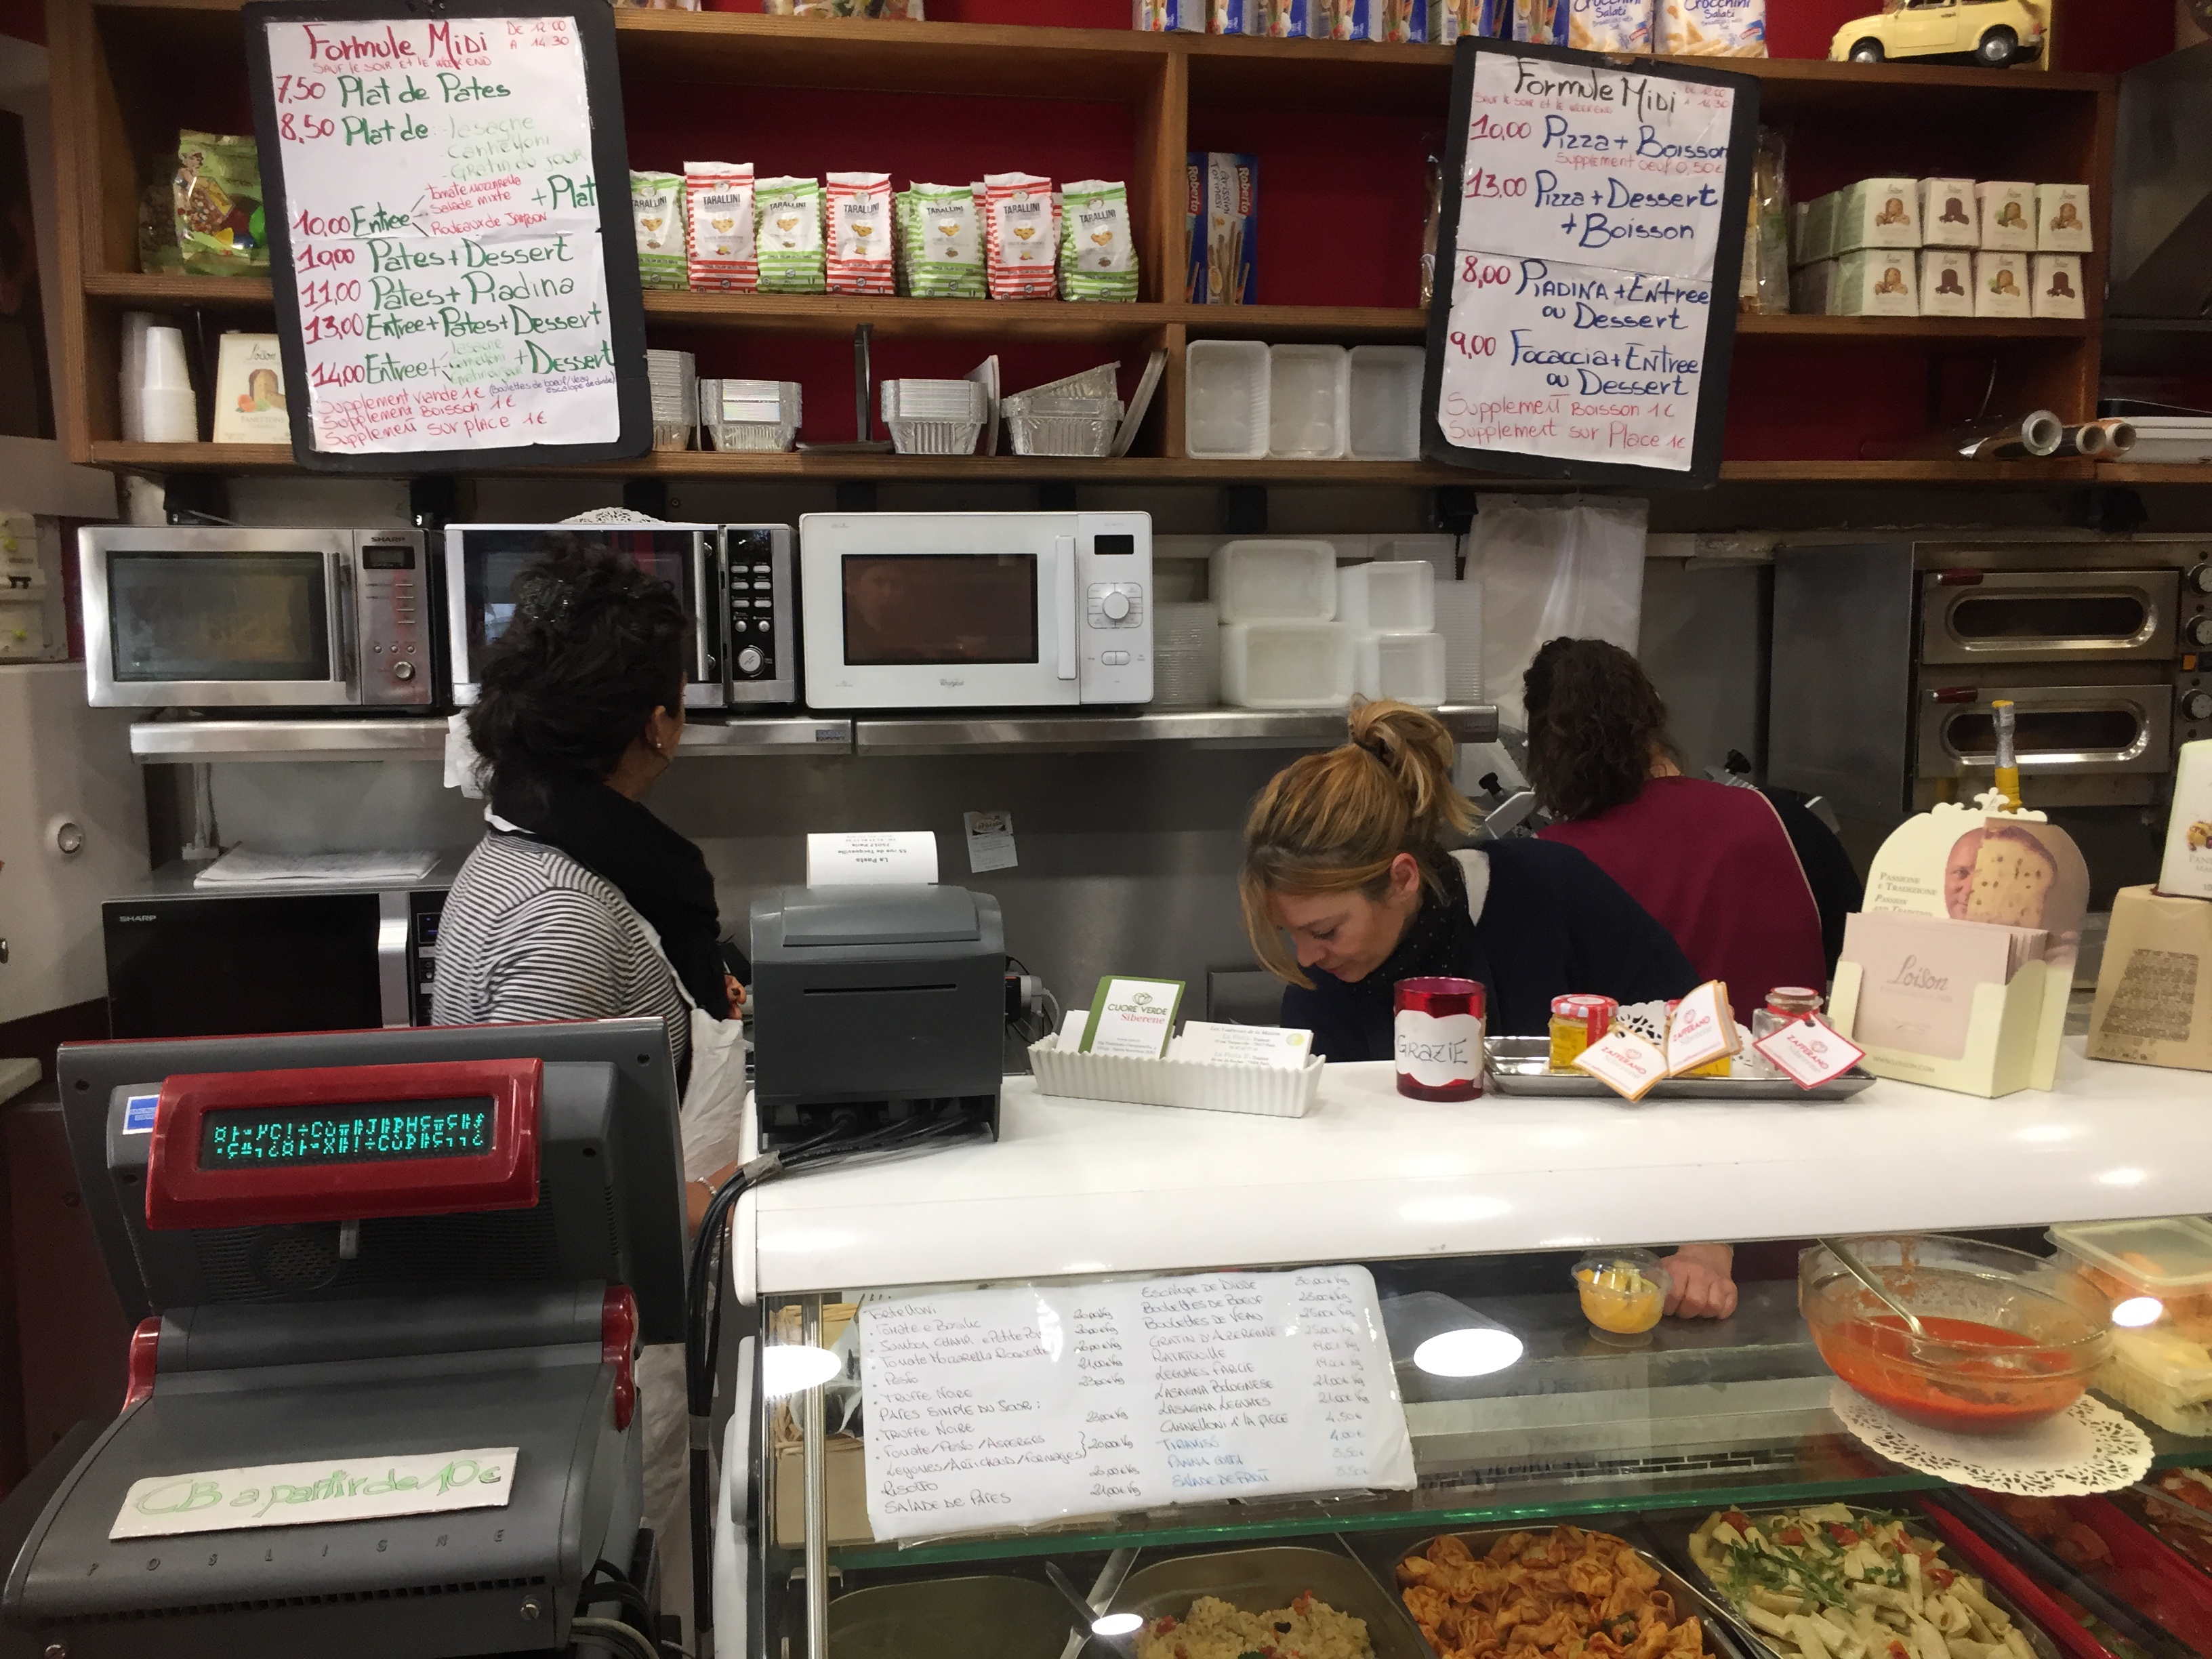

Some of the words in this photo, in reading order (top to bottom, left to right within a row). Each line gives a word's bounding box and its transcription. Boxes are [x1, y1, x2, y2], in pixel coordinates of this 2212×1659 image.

[303, 23, 415, 60] Formule
[337, 75, 390, 108] Plat
[398, 75, 430, 103] de
[436, 72, 511, 103] Pates
[1514, 60, 1614, 101] Formule
[342, 115, 395, 146] Plat
[1542, 114, 1610, 150] Pizza
[703, 193, 741, 206] TARALLINI
[1238, 167, 1251, 214] Roberto
[1534, 169, 1585, 208] Pizza
[1606, 177, 1718, 209] Dessert
[350, 201, 411, 237] Entree
[546, 173, 596, 210] Plat
[769, 201, 806, 211] TARALLINI
[844, 202, 880, 214] TARALLINI
[926, 205, 964, 216] TARALLINI
[1004, 203, 1041, 216] TARALLINI
[1079, 209, 1117, 224] TARALLINI
[1578, 213, 1695, 248] Boisson
[367, 239, 445, 274] Pates
[461, 236, 574, 268] Dessert
[367, 275, 445, 312] Pates
[461, 270, 575, 306] Piadina
[365, 312, 427, 341] Entree
[438, 306, 500, 338] Pates
[507, 302, 602, 336] Dessert
[1572, 302, 1689, 330] Dessert
[1510, 329, 1610, 367] Focaccia
[365, 352, 428, 384] Entree
[1578, 368, 1689, 396] Dessert
[1609, 420, 1660, 450] Place
[119, 914, 157, 923] SHARP
[1107, 1004, 1139, 1013] CUORE
[1141, 1006, 1168, 1015] VERDE
[1120, 1012, 1165, 1024] Siberene
[1673, 1016, 1711, 1042] ZAFFERANO
[1601, 1046, 1647, 1075] ZAFFERANO
[1786, 1033, 1829, 1070] ZAFFERANO
[136, 1479, 223, 1515] CB
